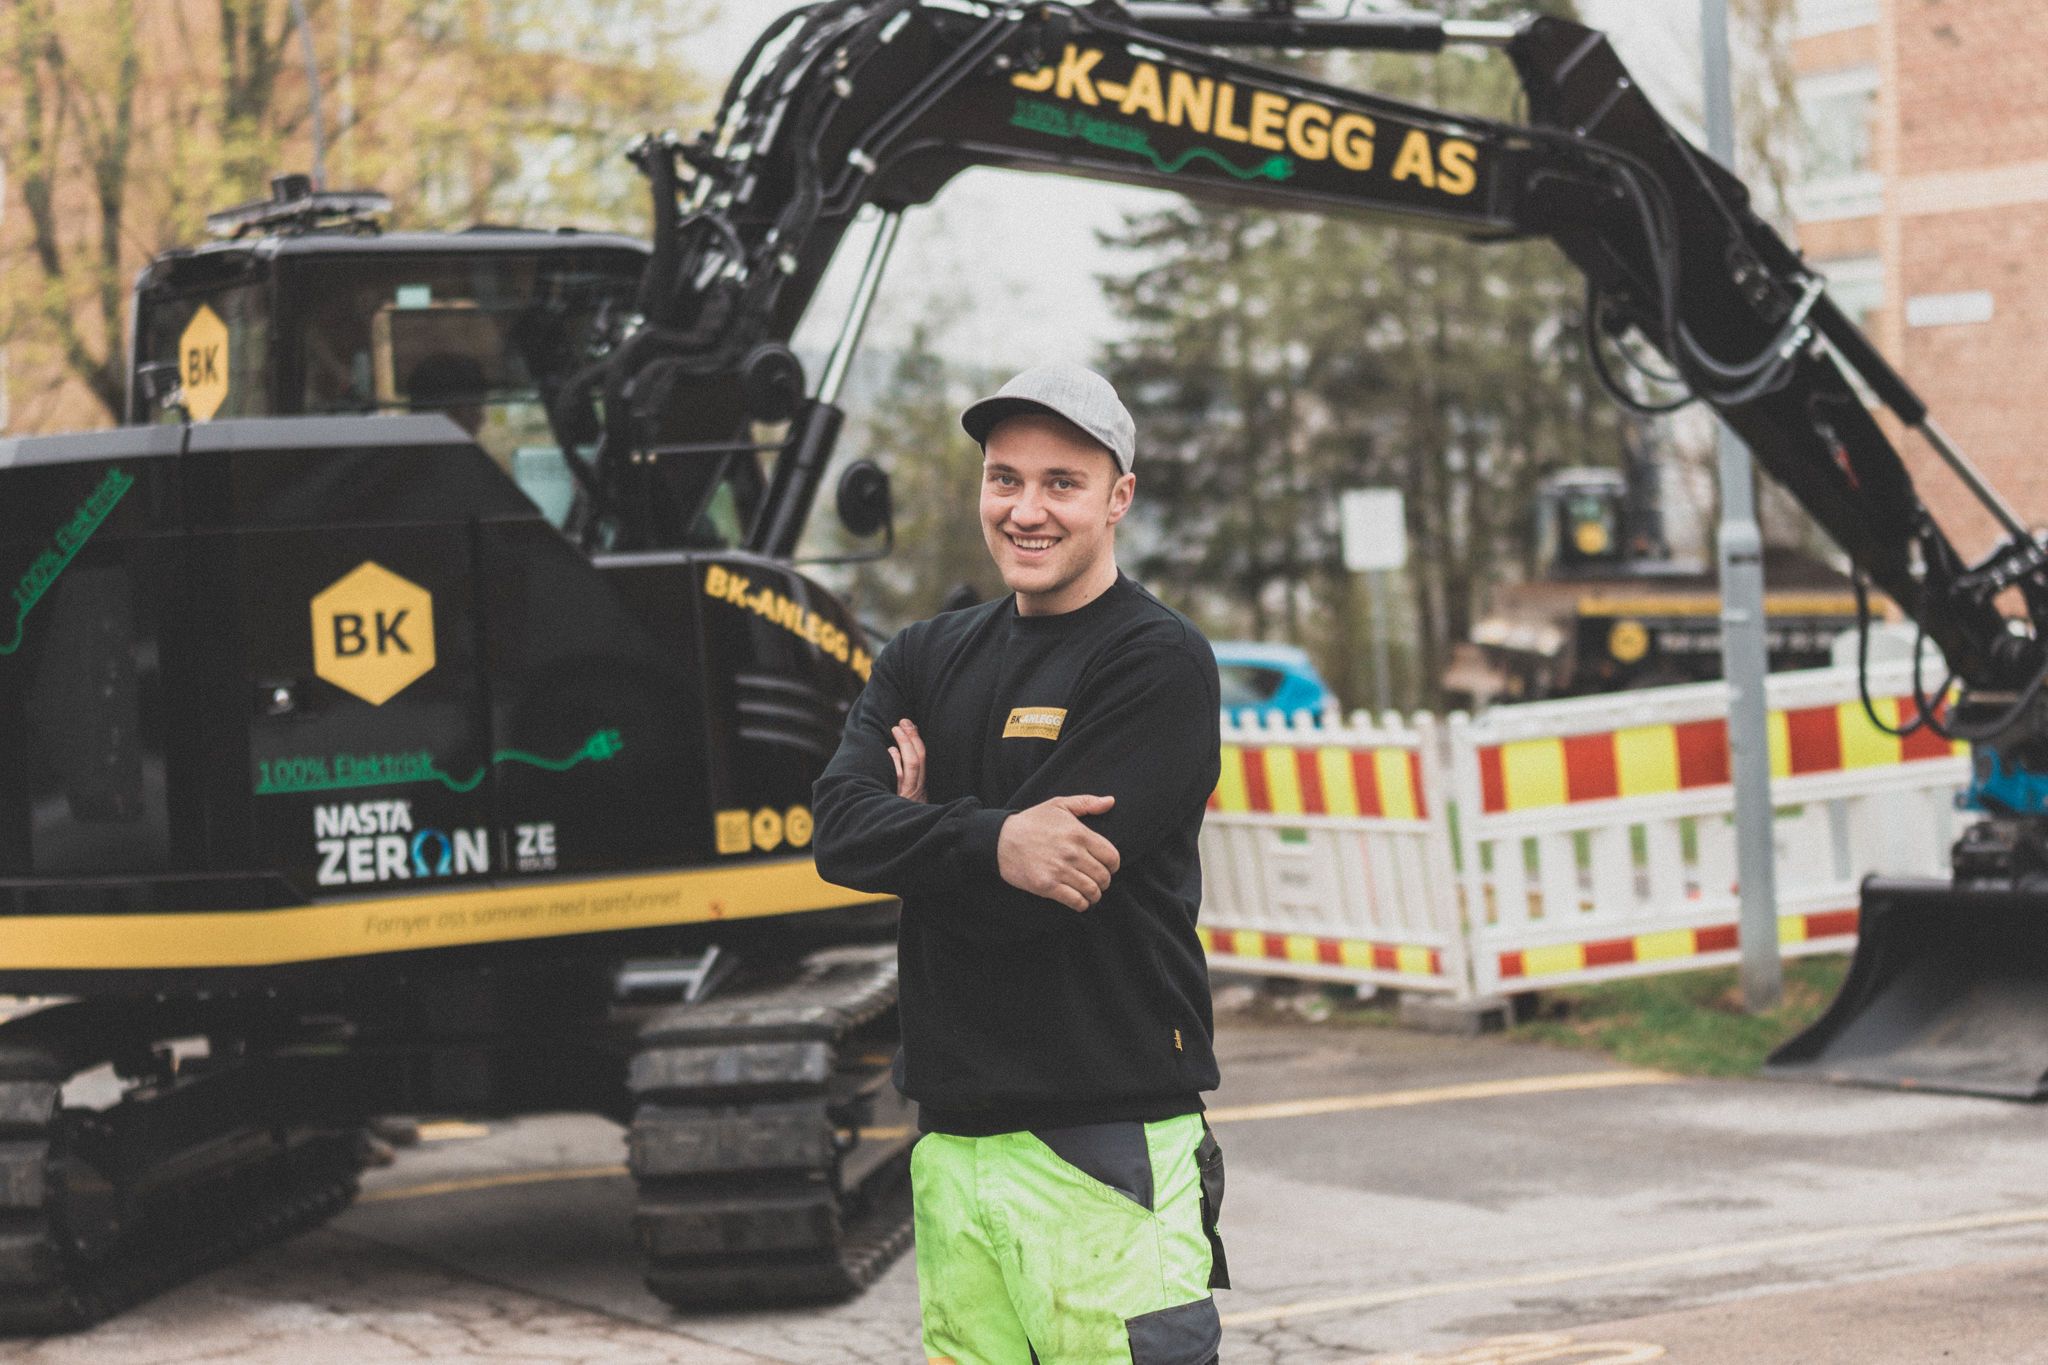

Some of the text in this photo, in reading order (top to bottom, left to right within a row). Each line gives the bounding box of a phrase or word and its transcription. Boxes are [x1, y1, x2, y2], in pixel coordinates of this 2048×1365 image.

[1391, 129, 1479, 196] AS
[188, 345, 219, 387] BK
[333, 609, 413, 658] BK
[705, 564, 849, 663] BK-ANLEGG
[314, 800, 412, 838] NASTA
[516, 824, 557, 857] ZE
